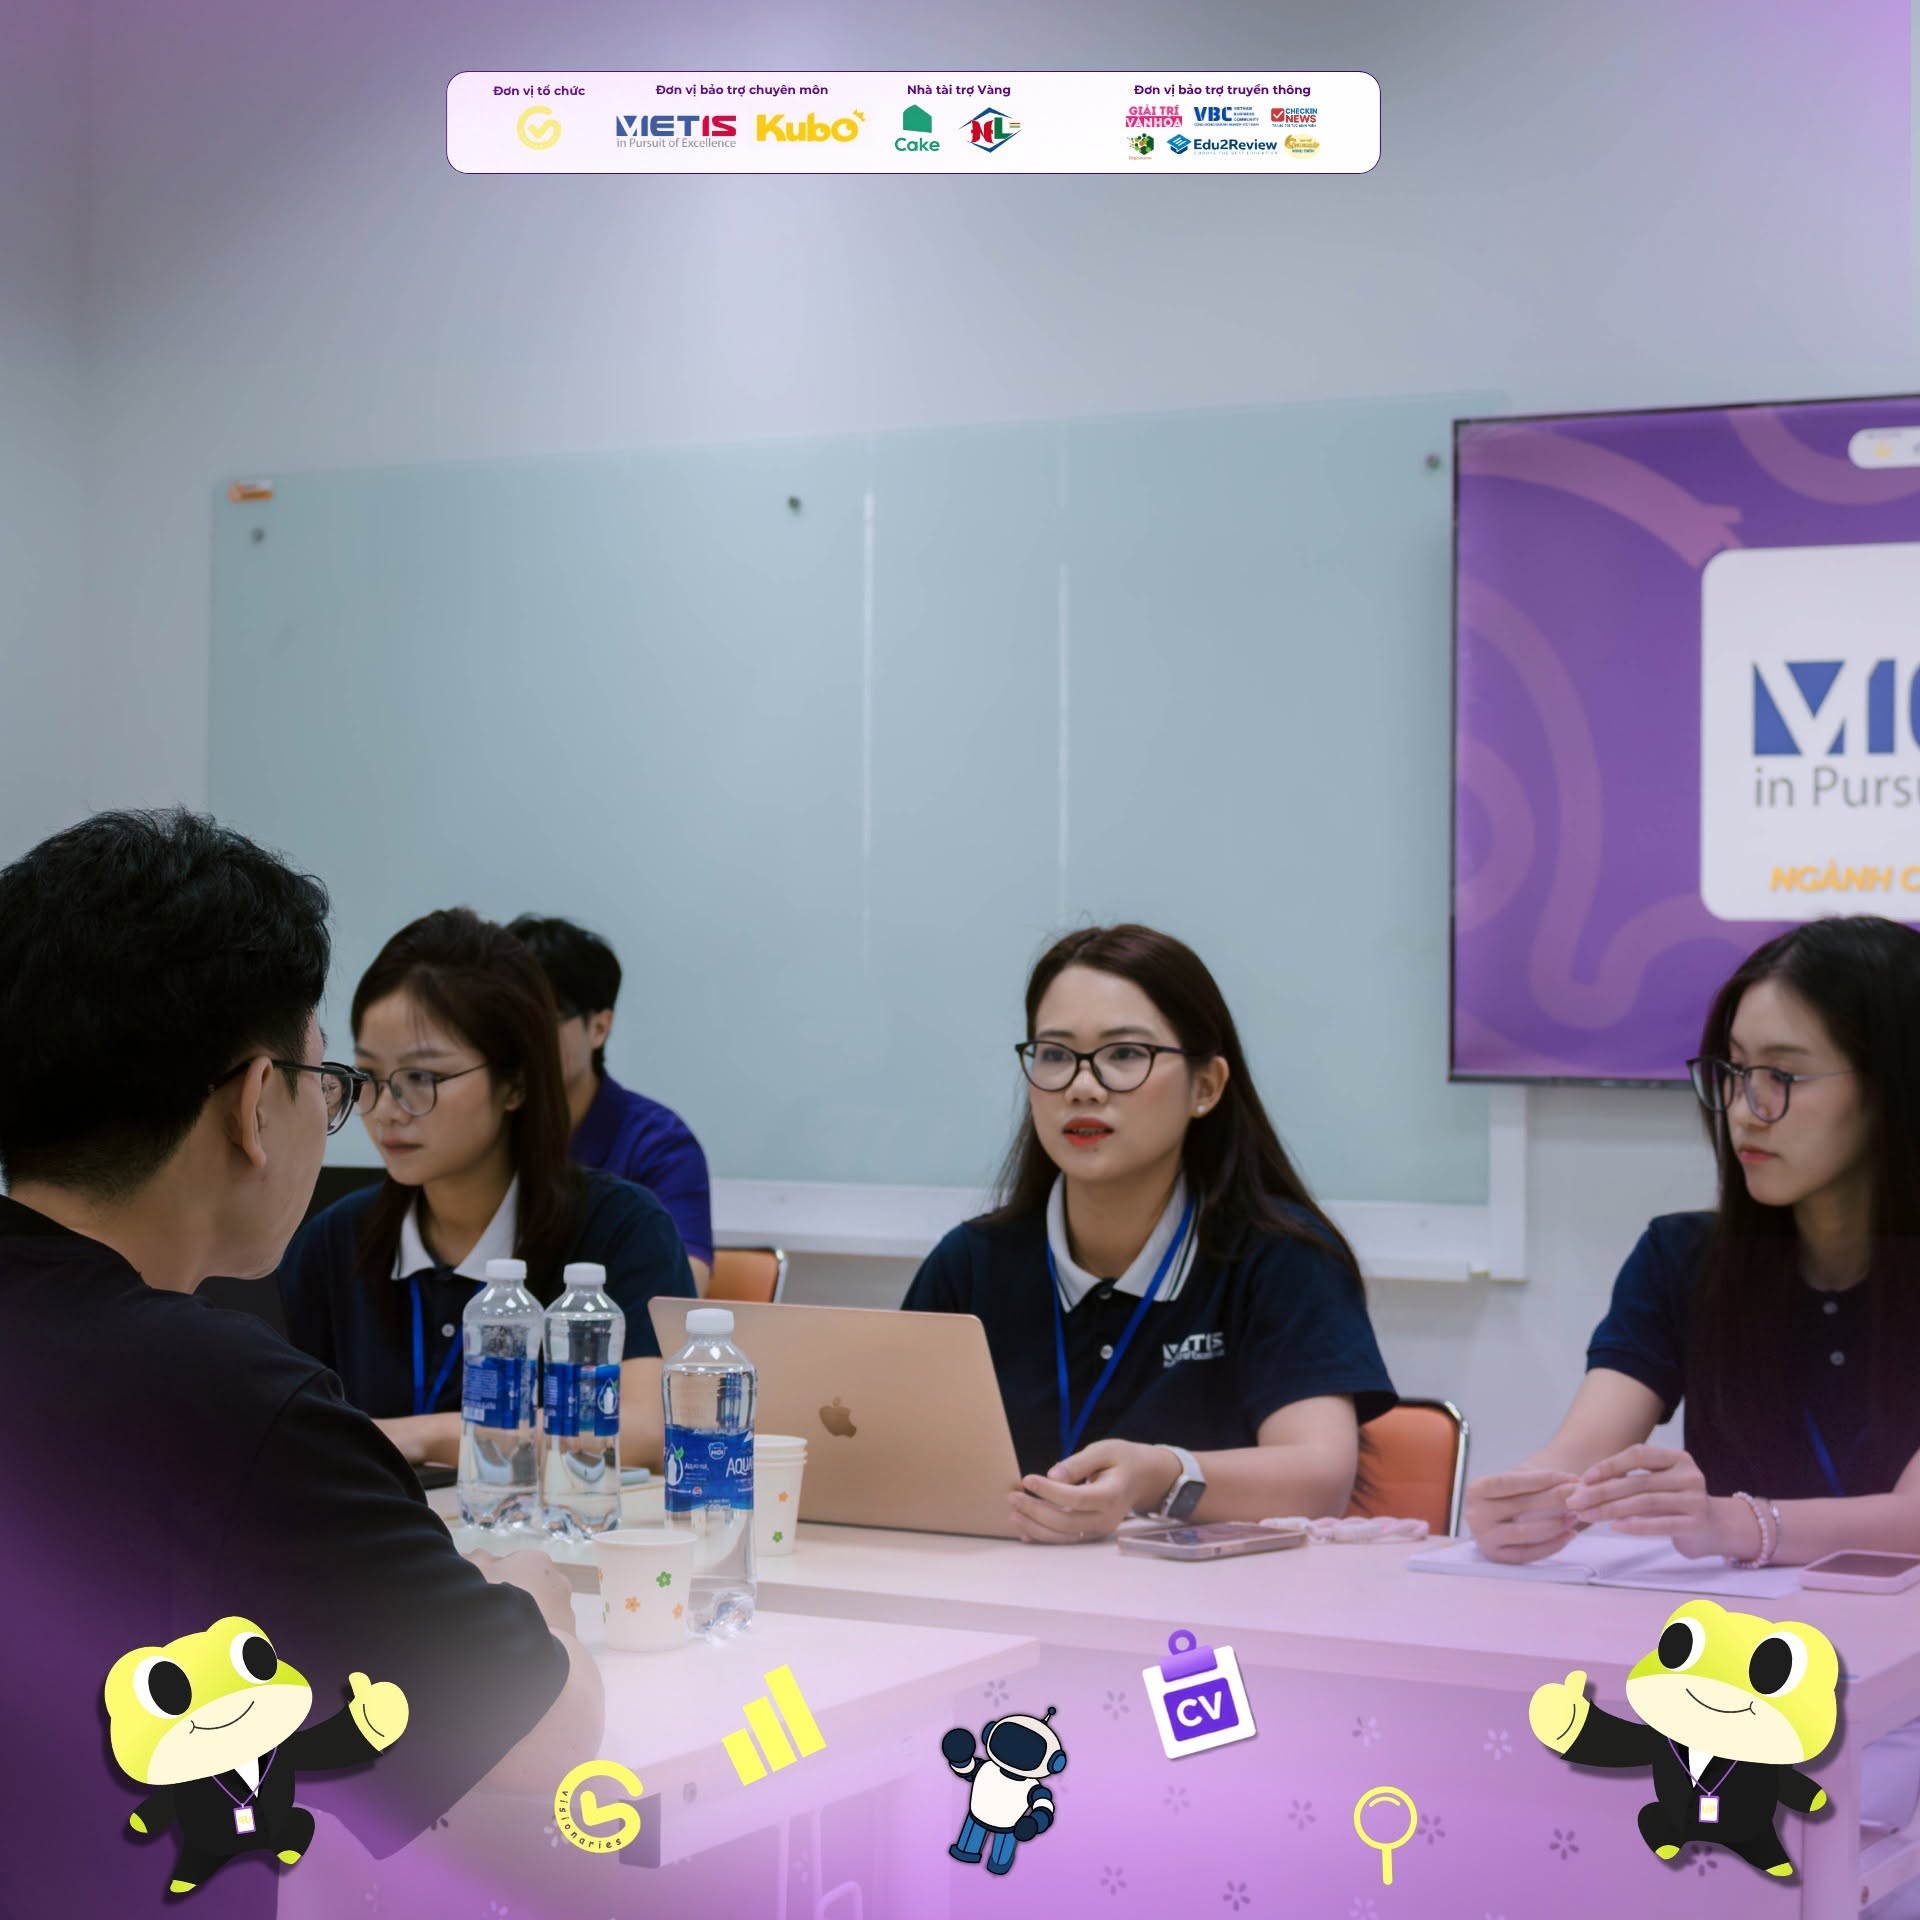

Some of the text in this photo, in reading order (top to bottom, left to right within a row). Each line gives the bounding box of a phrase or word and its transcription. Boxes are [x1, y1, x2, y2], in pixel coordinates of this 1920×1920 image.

[1755, 765, 1920, 808] in Purs
[1769, 858, 1894, 893] NGÀNH
